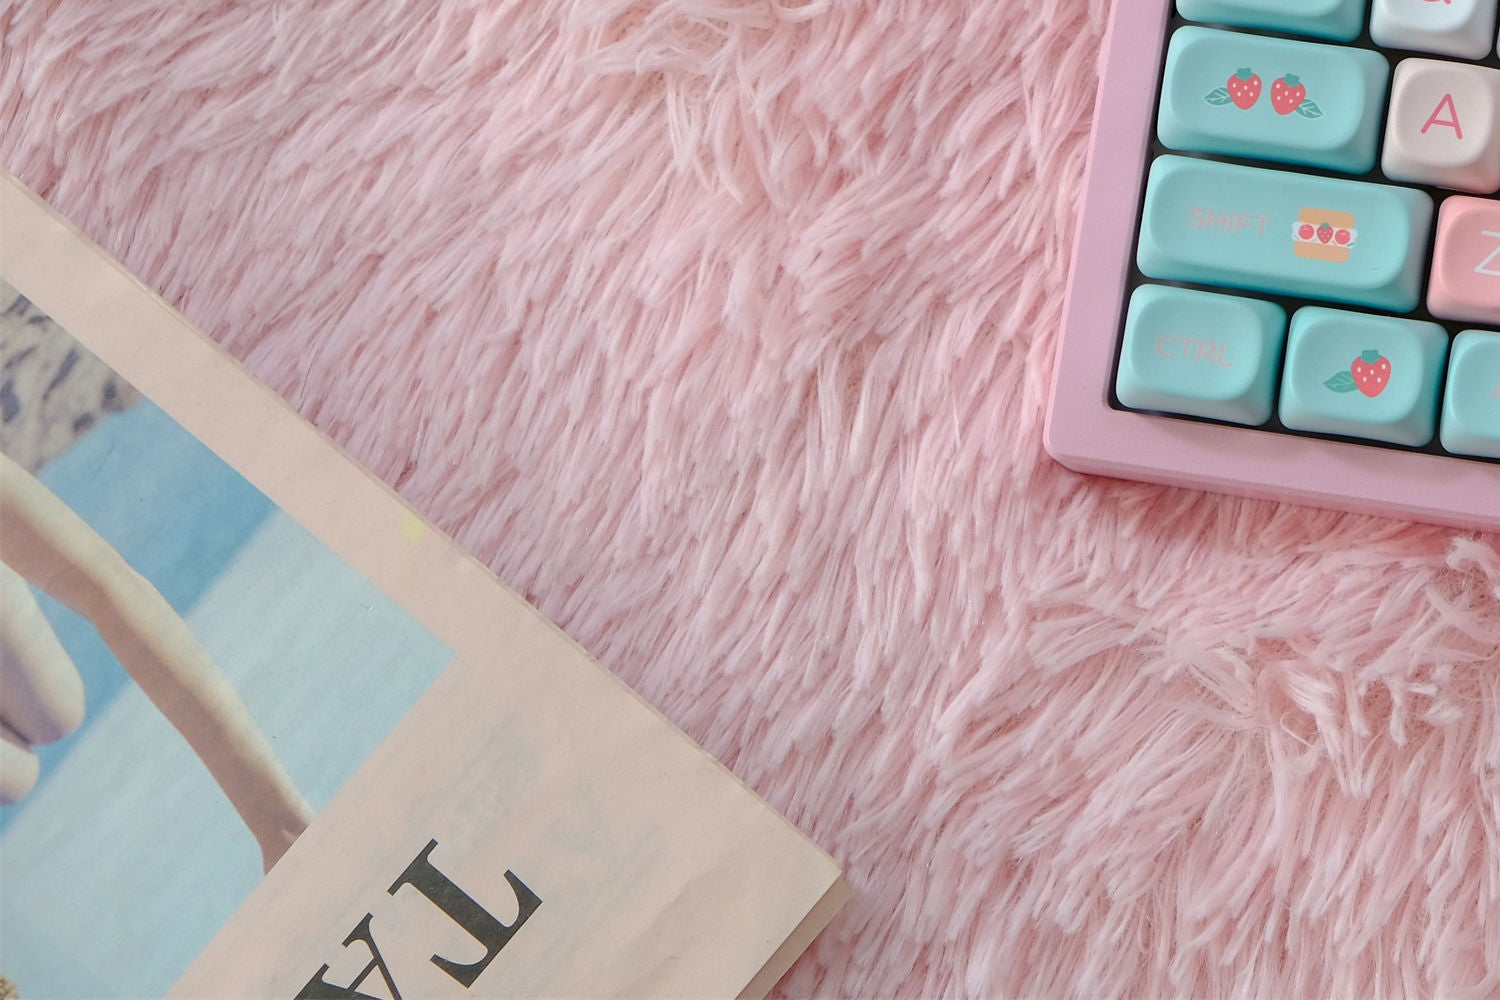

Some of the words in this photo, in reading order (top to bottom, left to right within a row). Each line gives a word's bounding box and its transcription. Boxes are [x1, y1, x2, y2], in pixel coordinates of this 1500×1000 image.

[1420, 93, 1464, 140] A
[1188, 205, 1272, 238] SHIFT
[1155, 333, 1233, 368] CTRL
